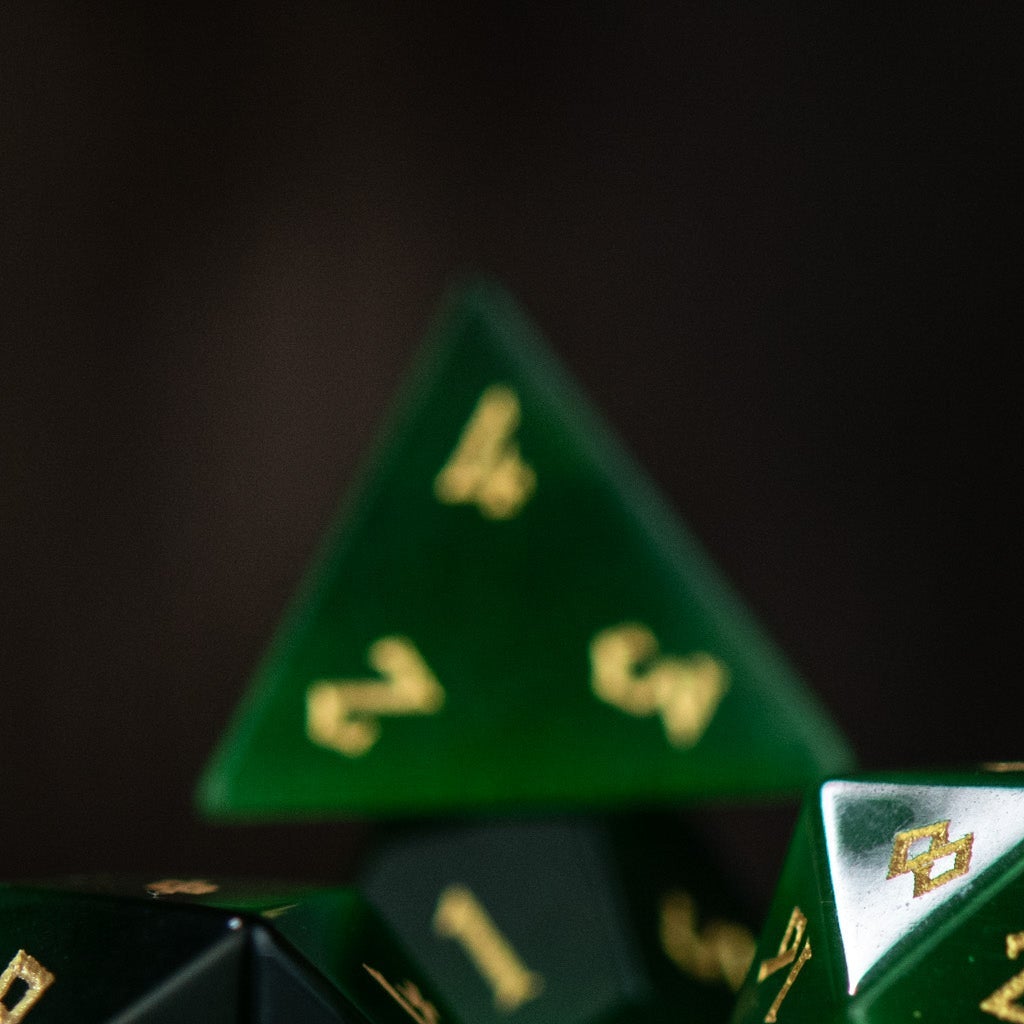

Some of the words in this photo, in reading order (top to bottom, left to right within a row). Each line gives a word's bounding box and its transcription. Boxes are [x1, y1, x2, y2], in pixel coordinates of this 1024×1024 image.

[436, 384, 535, 520] 4
[306, 634, 444, 757] 2
[590, 622, 728, 748] 3
[886, 820, 975, 898] 8
[432, 885, 545, 1012] 1
